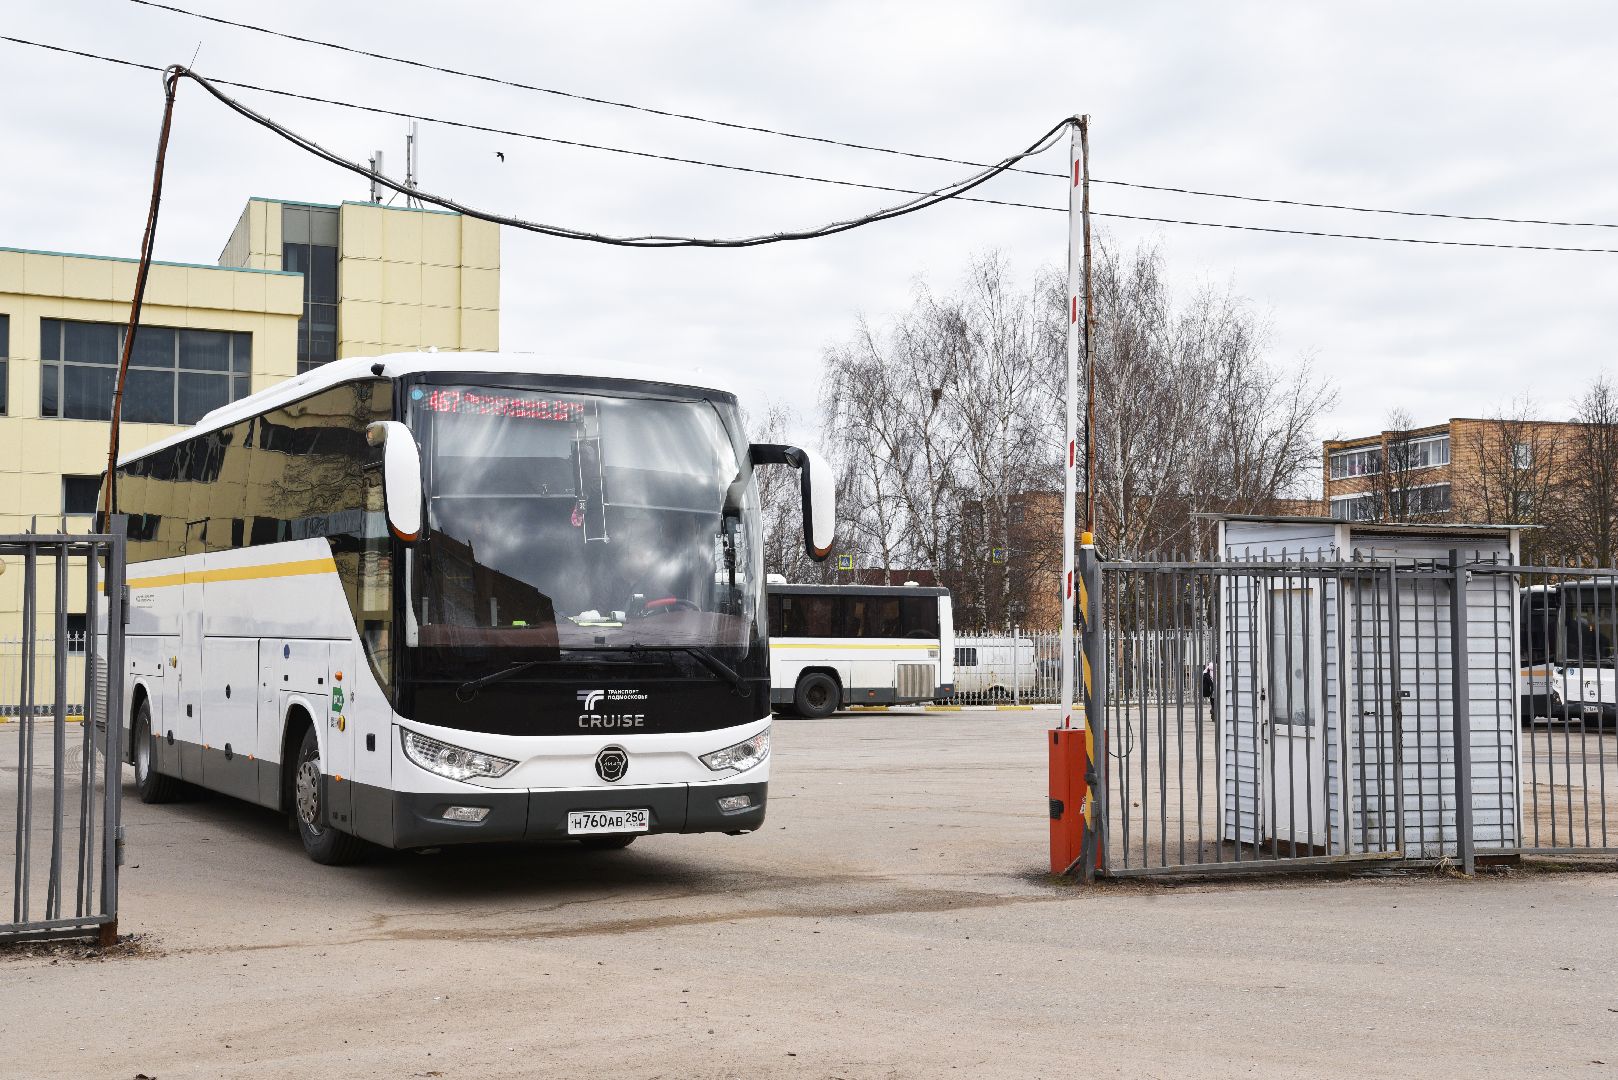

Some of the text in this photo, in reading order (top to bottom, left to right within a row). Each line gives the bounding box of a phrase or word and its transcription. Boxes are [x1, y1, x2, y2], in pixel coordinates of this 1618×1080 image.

[430, 390, 460, 413] 467
[578, 714, 645, 728] CRUISE
[625, 811, 644, 823] 250
